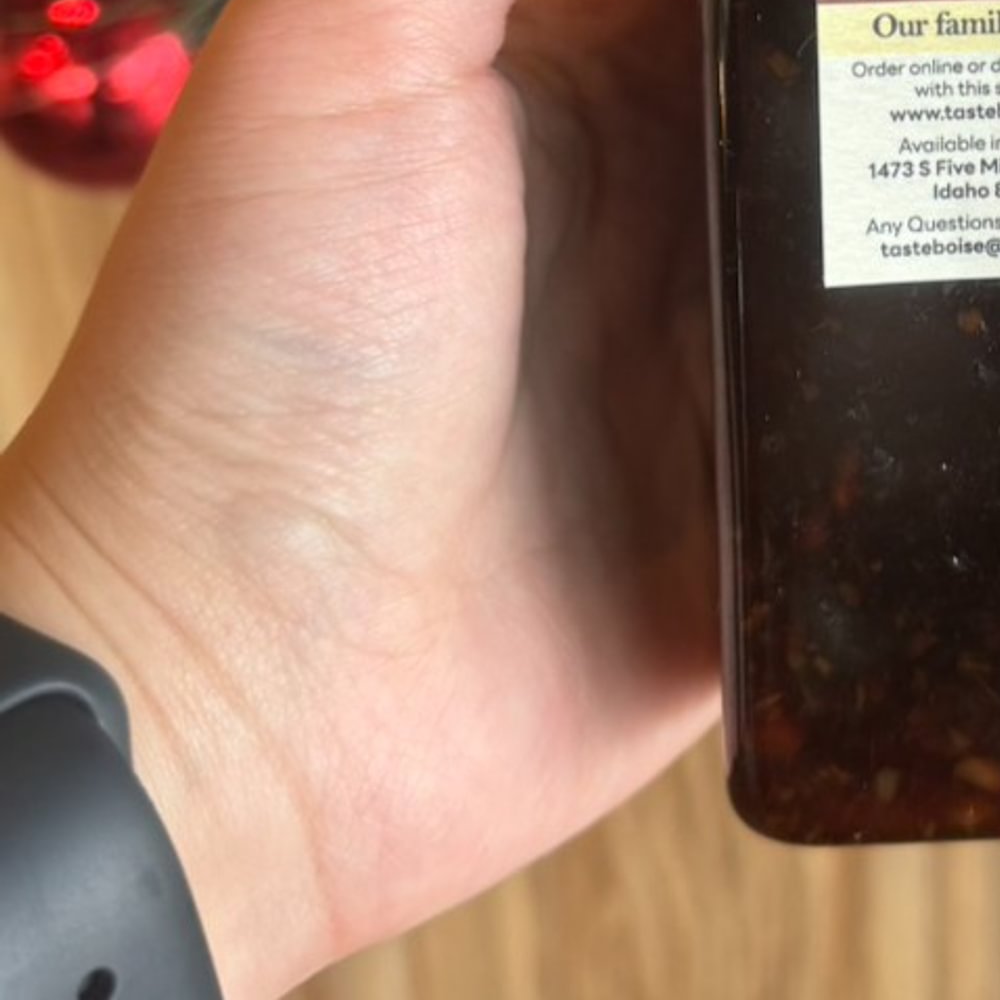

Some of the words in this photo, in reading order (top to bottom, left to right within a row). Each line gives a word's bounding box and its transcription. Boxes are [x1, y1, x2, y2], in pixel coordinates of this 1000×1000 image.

[873, 13, 928, 38] Our
[852, 60, 903, 78] Order
[909, 59, 963, 75] online
[967, 60, 985, 73] or
[915, 82, 954, 97] with
[958, 81, 990, 96] this
[899, 136, 985, 154] Available
[868, 162, 914, 178] 1473
[919, 160, 931, 176] S
[936, 159, 975, 176] Five
[933, 182, 989, 200] Idaho
[866, 217, 903, 236] Any
